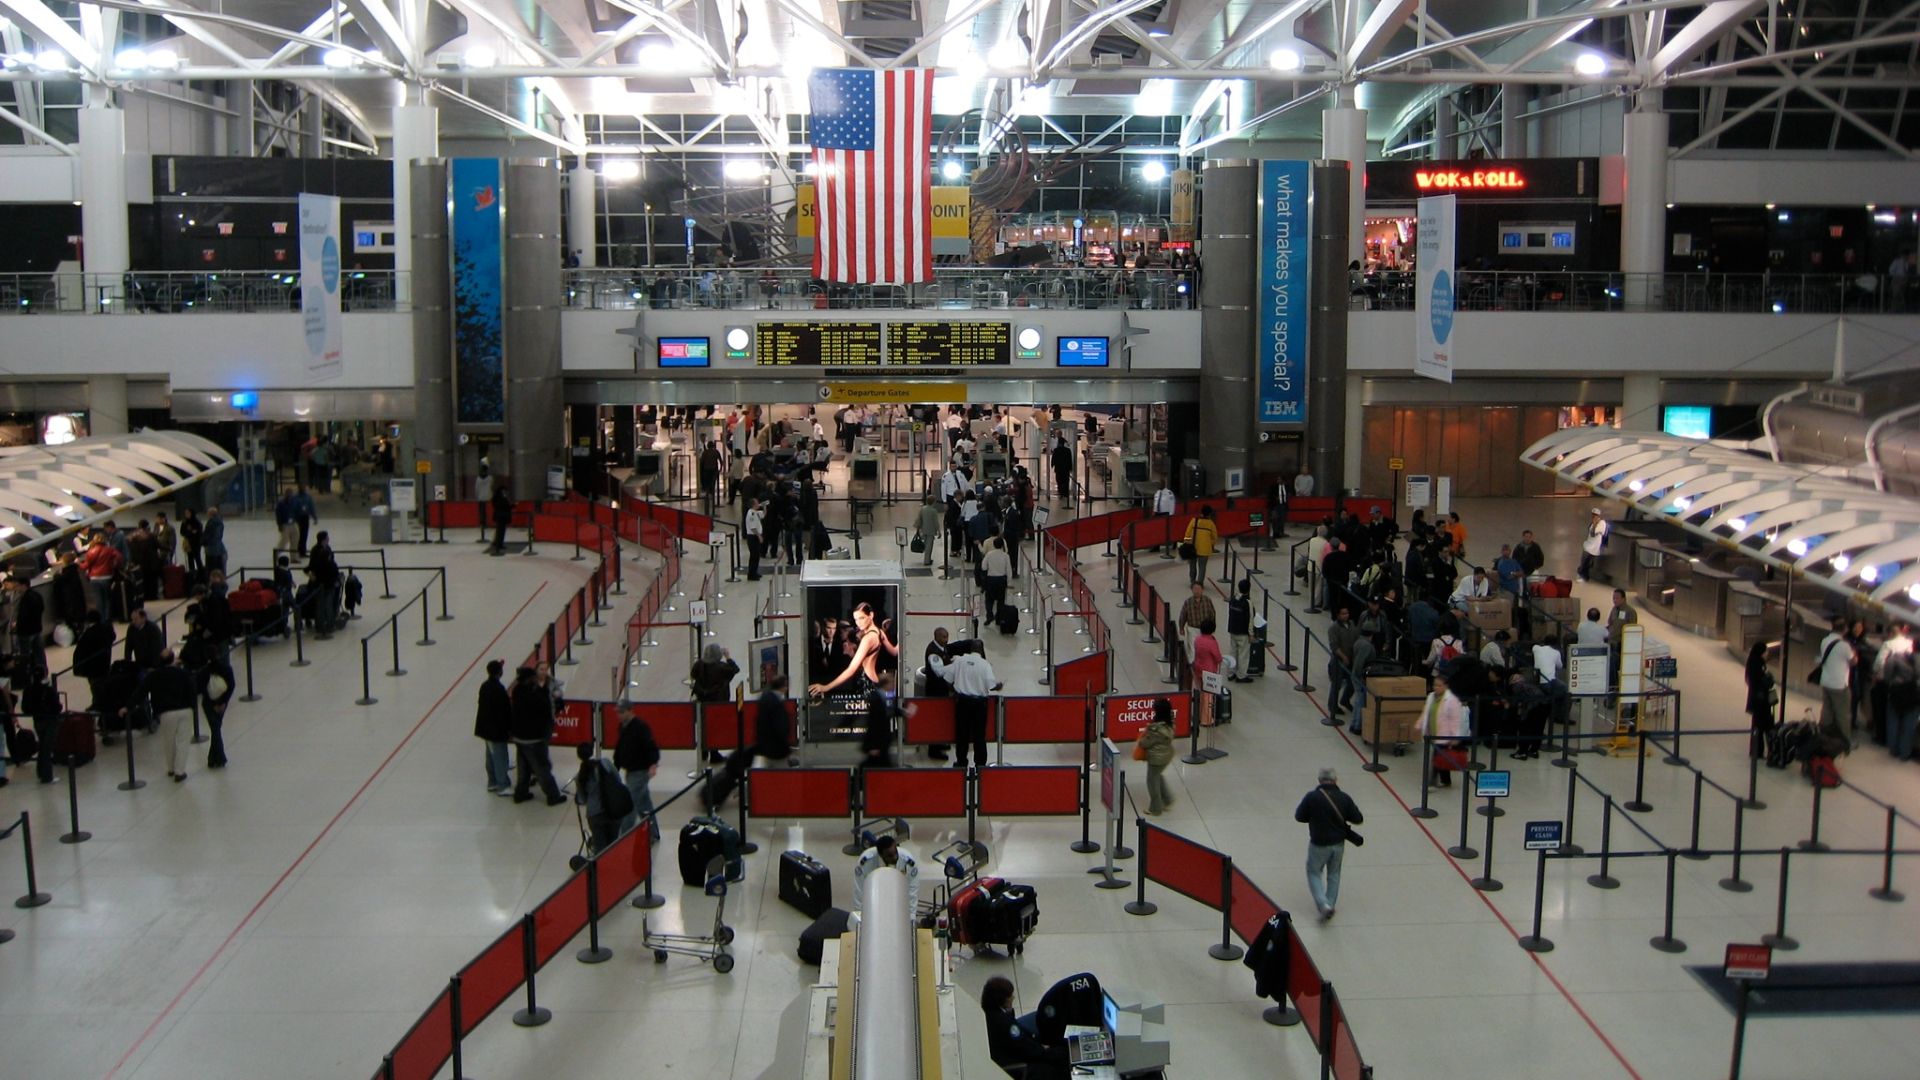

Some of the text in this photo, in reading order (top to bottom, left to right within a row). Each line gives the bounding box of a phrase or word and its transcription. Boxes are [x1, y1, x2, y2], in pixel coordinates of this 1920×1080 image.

[1416, 173, 1459, 187] WOK
[1270, 174, 1293, 391] what makes you special?
[848, 389, 910, 398] Departure Gates
[1265, 401, 1297, 415] IBM
[1070, 978, 1090, 992] TSA
